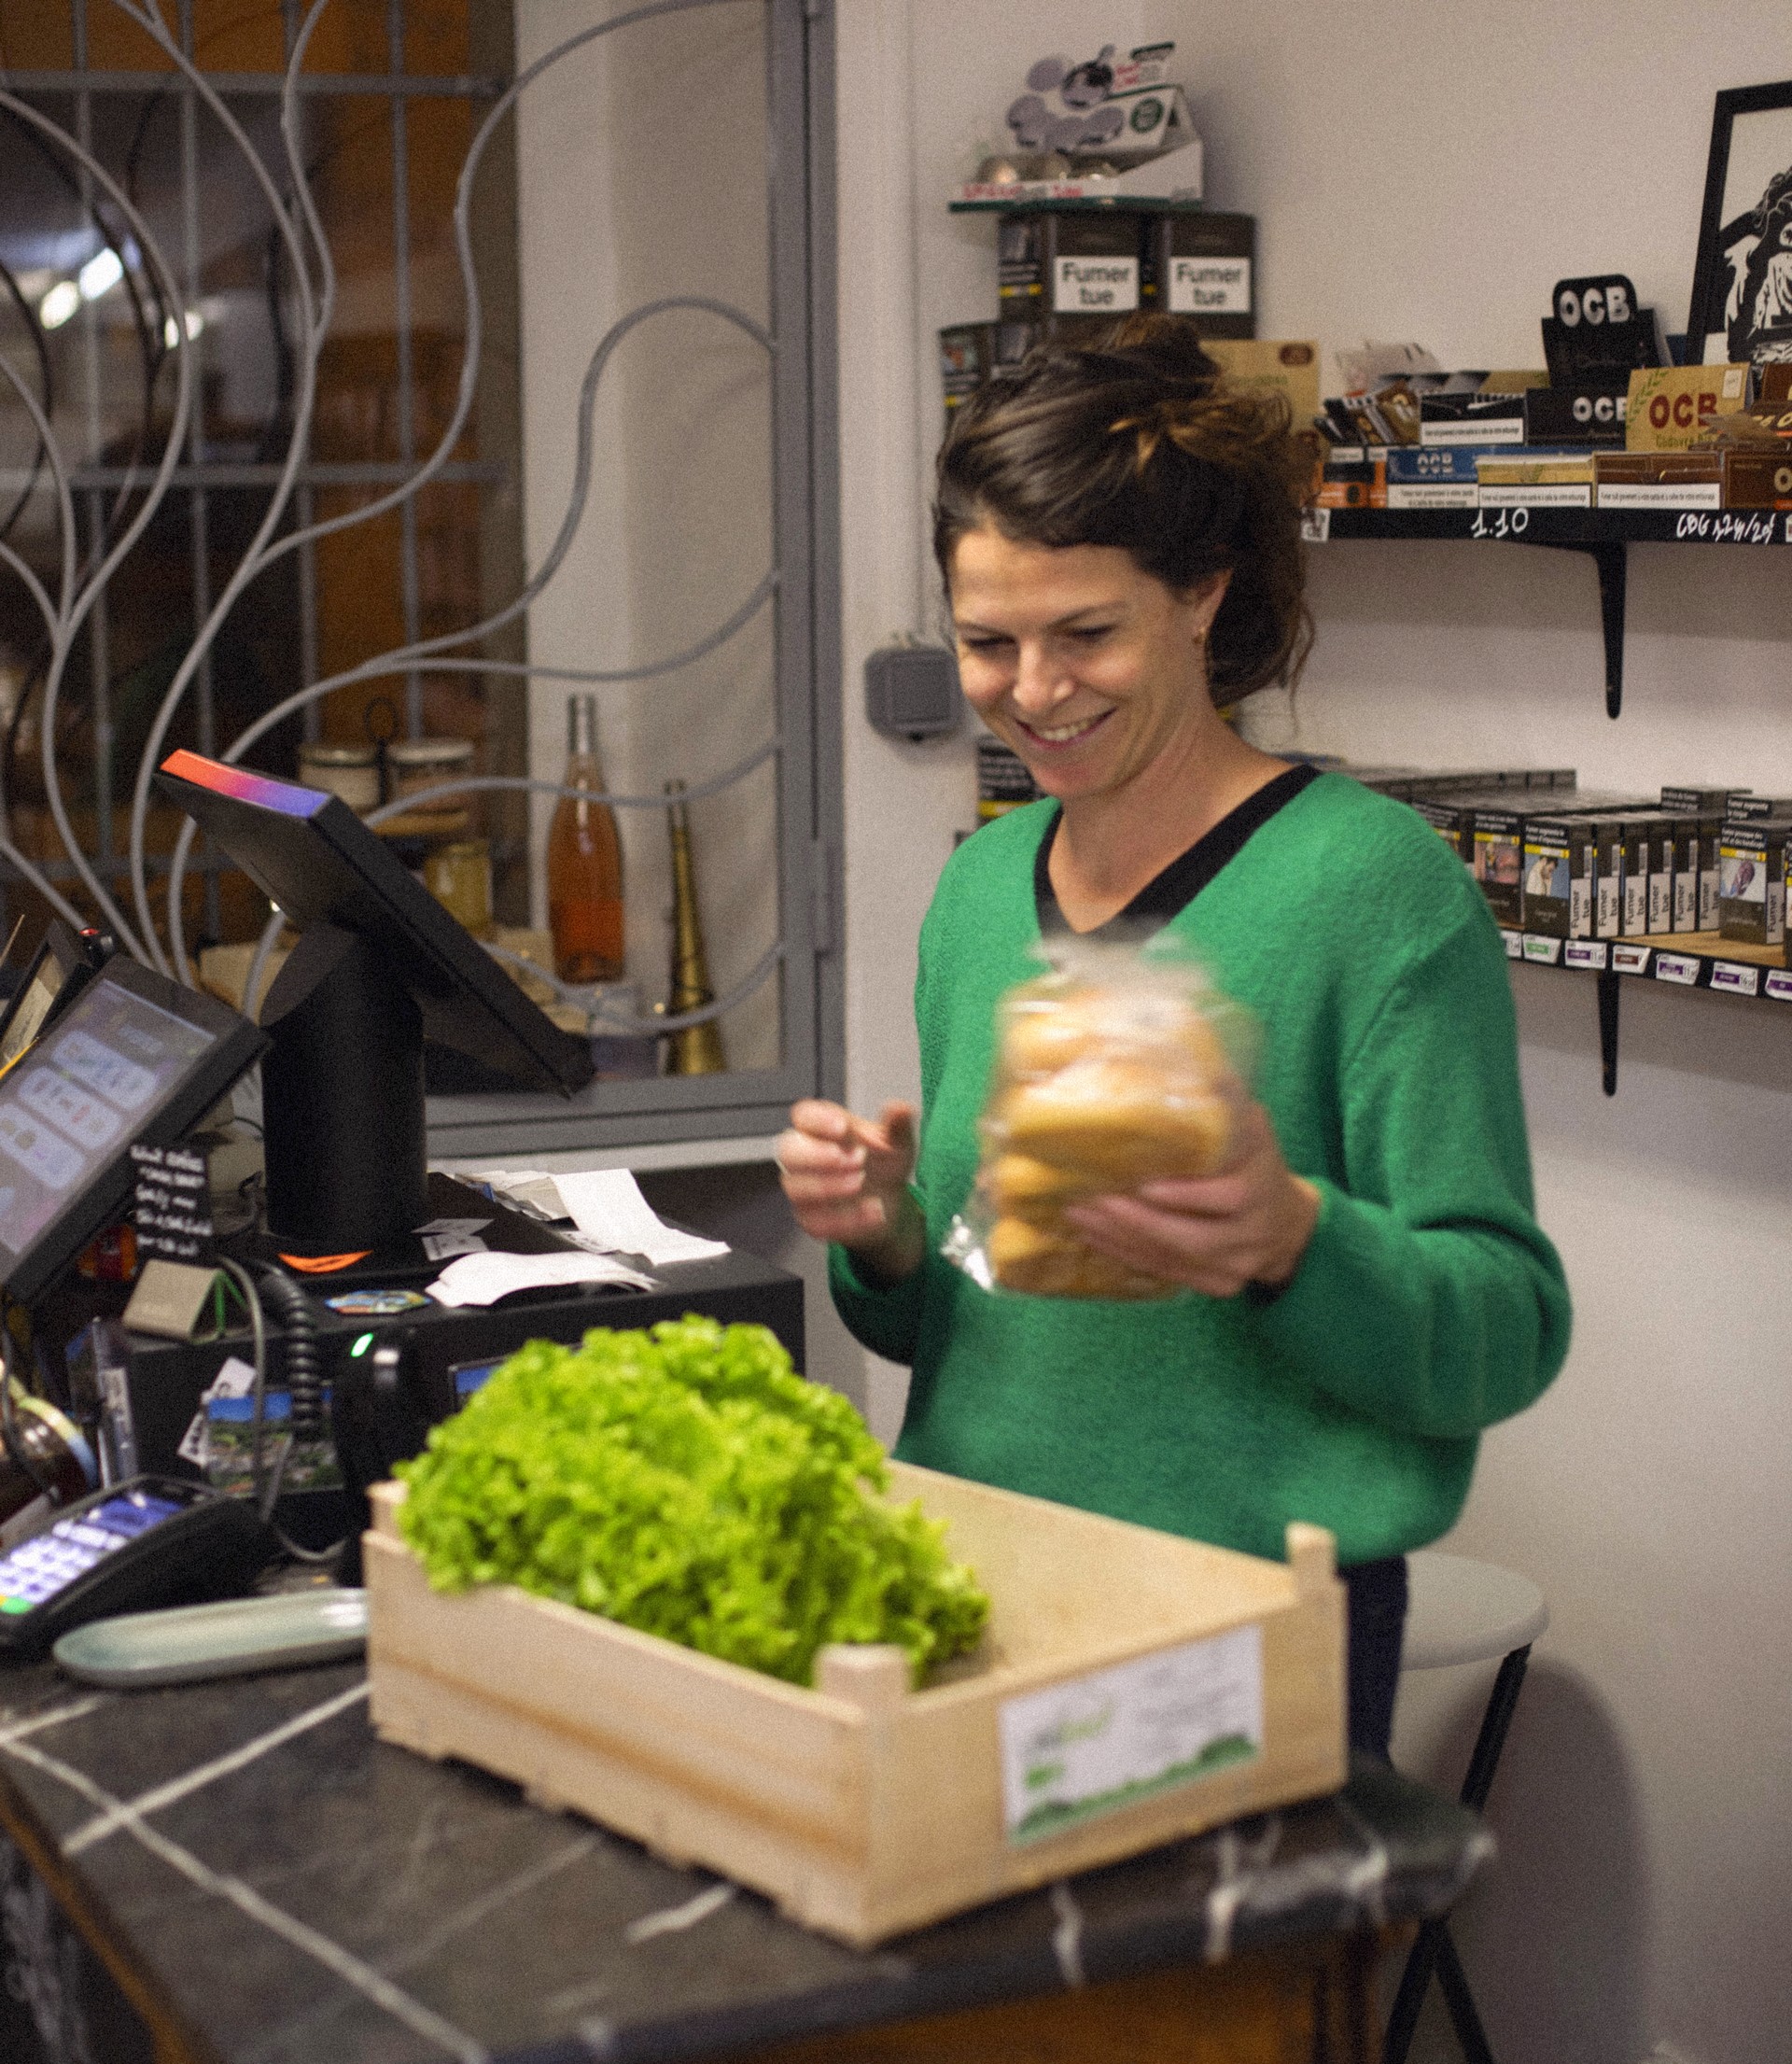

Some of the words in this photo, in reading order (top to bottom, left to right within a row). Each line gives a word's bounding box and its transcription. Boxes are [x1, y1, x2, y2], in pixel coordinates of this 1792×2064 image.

[1062, 261, 1129, 282] Fumer
[1176, 262, 1241, 283] Fumer
[1079, 287, 1114, 305] tue
[1194, 288, 1227, 306] tue
[1559, 286, 1631, 328] OCB
[1649, 393, 1717, 429] OCB
[1470, 508, 1529, 539] 1.10
[1571, 891, 1580, 928] Fumer
[1598, 890, 1607, 926] Fumer
[1625, 888, 1634, 925] Fumer
[1650, 886, 1659, 922] Fumer
[1675, 884, 1685, 921] Fumer
[1701, 882, 1710, 920] Fumer
